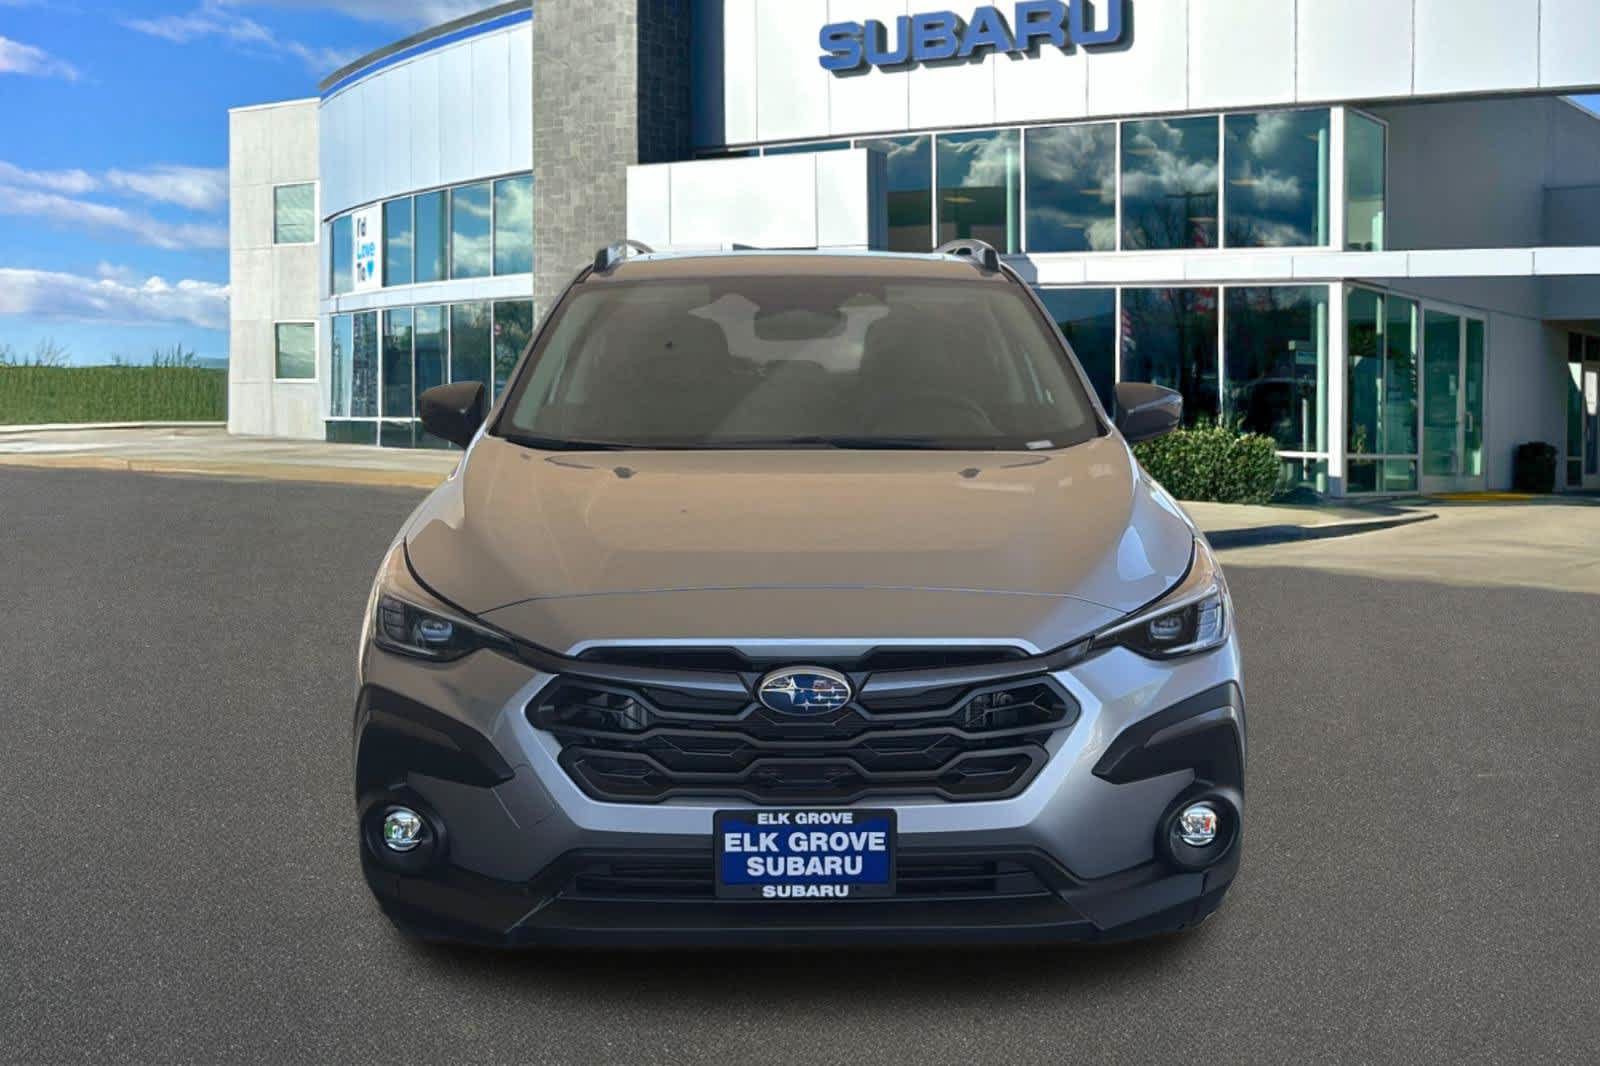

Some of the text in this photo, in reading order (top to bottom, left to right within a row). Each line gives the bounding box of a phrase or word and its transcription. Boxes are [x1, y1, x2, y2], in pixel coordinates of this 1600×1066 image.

[818, 0, 1134, 79] SUBARU
[757, 812, 853, 825] ELK GROVE
[724, 831, 886, 852] ELK GROVE
[746, 855, 863, 876] SUBARU
[762, 884, 849, 898] SUBARU
